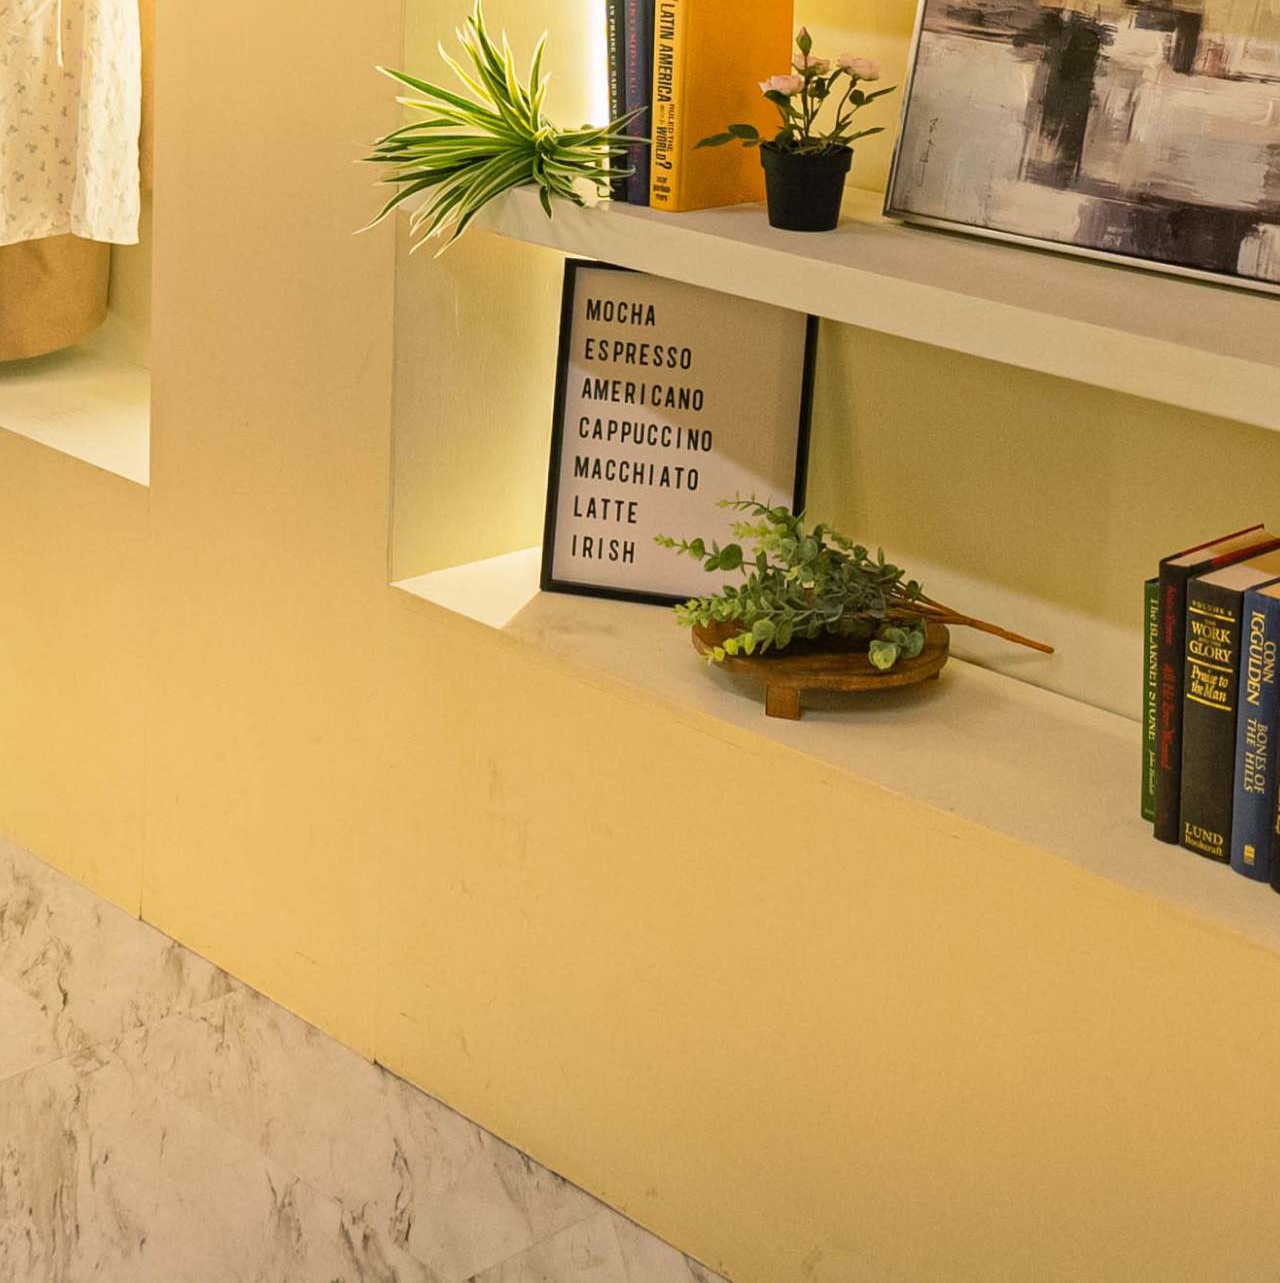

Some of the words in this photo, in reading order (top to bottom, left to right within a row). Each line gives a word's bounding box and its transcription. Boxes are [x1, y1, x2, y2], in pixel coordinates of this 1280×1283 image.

[609, 18, 617, 53] PRAISE
[659, 2, 676, 41] LATIN
[656, 43, 674, 103] AMERICA
[667, 103, 675, 134] RULED
[655, 126, 673, 170] WORLD?
[585, 298, 657, 327] MOCHA
[584, 338, 692, 370] ESPRESSO
[581, 377, 705, 411] AMERICANO
[578, 416, 713, 452] CAPPUCCINO
[573, 455, 700, 491] MACCHIATO
[573, 495, 639, 524] LATTE
[571, 534, 636, 564] IRISH
[1191, 620, 1232, 644] WORK
[1189, 639, 1233, 663] GLORY
[1247, 610, 1266, 706] IGGULDEN
[1262, 641, 1277, 684] CONN
[1191, 664, 1218, 684] Praise
[1218, 675, 1229, 688] to
[1191, 680, 1204, 695] the
[1203, 683, 1227, 703] Man
[1246, 718, 1258, 747] THE
[1255, 723, 1268, 771] BONES
[1243, 752, 1255, 794] HILLS
[1253, 774, 1266, 795] OF
[1184, 822, 1223, 845] LUND
